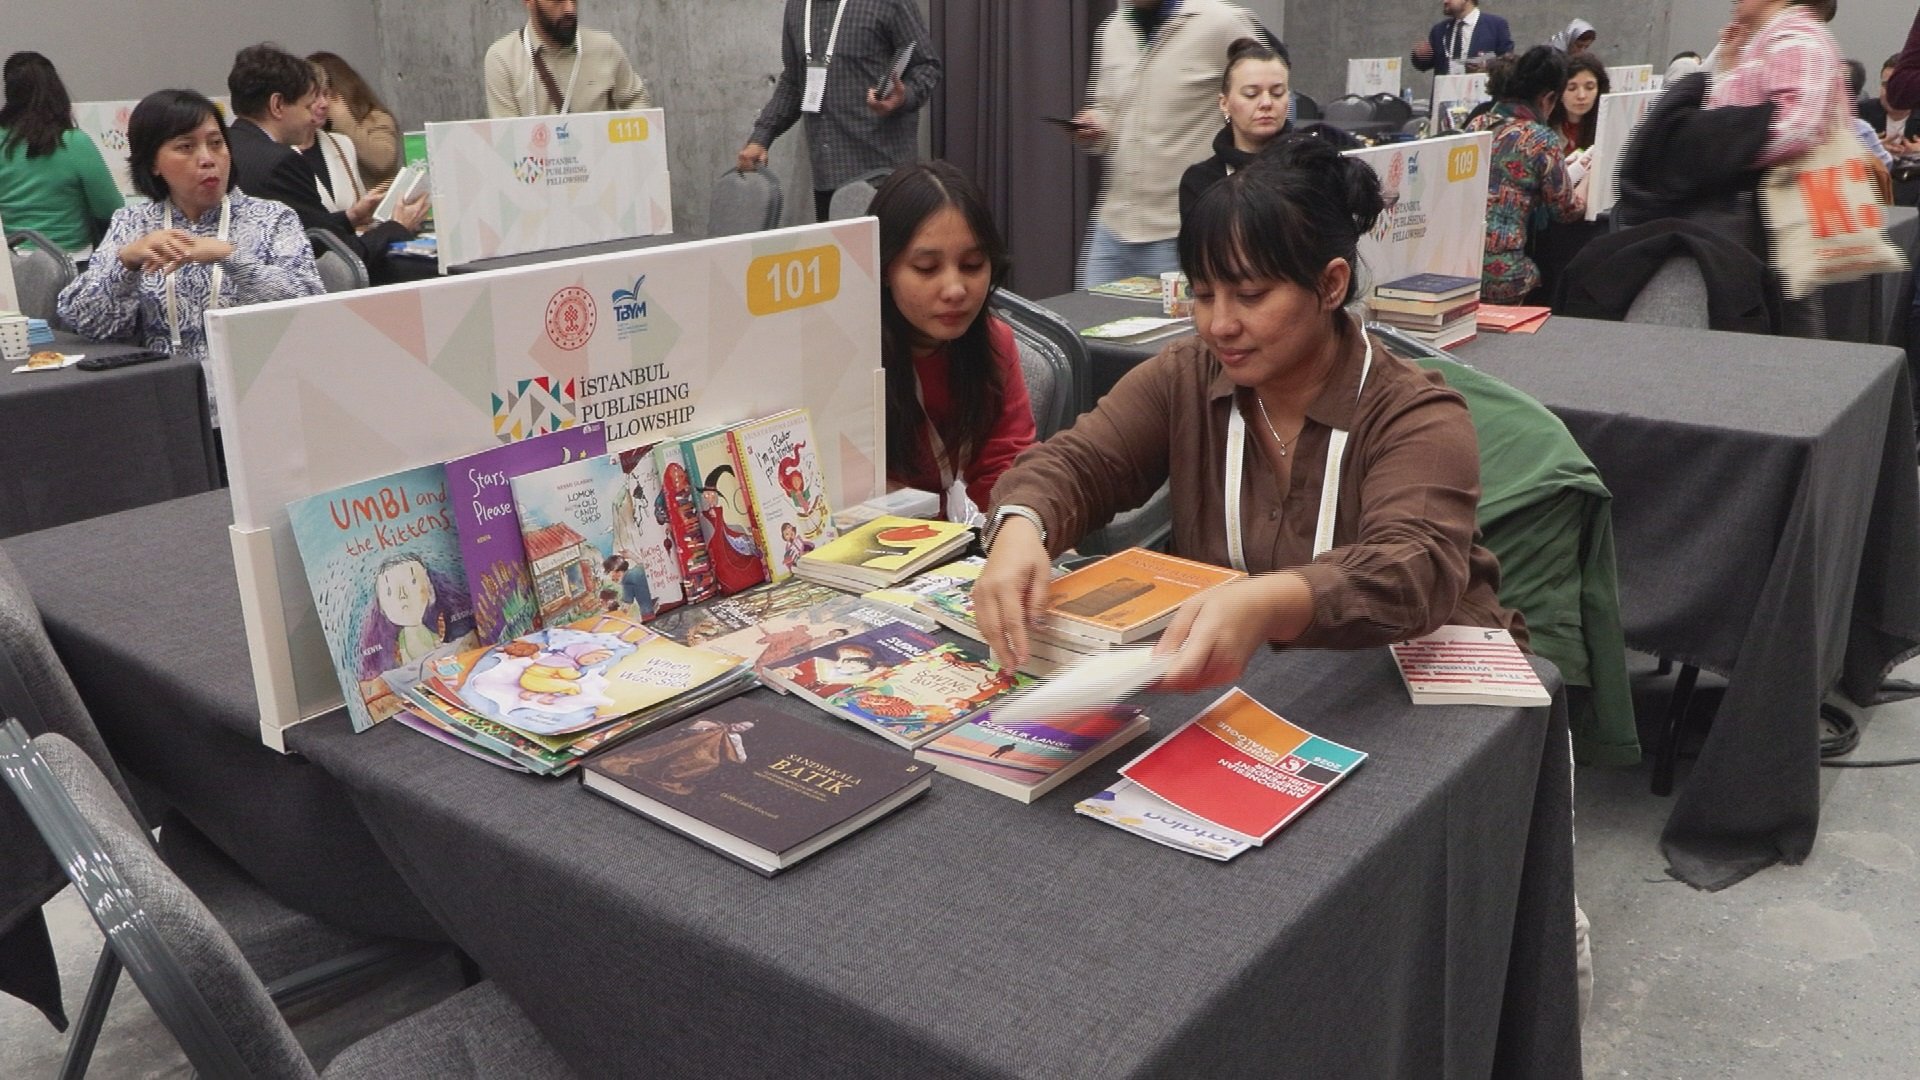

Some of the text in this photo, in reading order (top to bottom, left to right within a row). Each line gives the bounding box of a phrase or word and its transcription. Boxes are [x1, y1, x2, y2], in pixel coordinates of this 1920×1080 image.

[616, 121, 641, 138] 111
[1454, 150, 1473, 176] 109
[546, 174, 590, 186] FELLOWSHIP
[766, 255, 821, 302] 101
[613, 301, 647, 322] TBYM
[580, 362, 670, 398] İSTANBUL
[581, 382, 690, 423] PUBLISHING
[606, 405, 696, 442] LLOWSHIP
[468, 468, 510, 498] Stars,
[329, 482, 447, 530] UMBI and
[472, 500, 512, 526] Please
[346, 508, 451, 557] the Kittens
[362, 643, 383, 657] KENYA
[647, 657, 692, 671] When
[619, 670, 689, 689] Was Sick
[916, 669, 970, 693] SAVING
[1216, 720, 1280, 760] CATALOGUE
[1234, 739, 1275, 763] RIGHTS
[767, 758, 853, 796] BATIK
[787, 753, 862, 785] SANDYAKALA
[1217, 758, 1288, 793] INDONESIAN
[1234, 760, 1310, 796] INDEPENDENT
[1254, 762, 1317, 790] PUBLISHER
